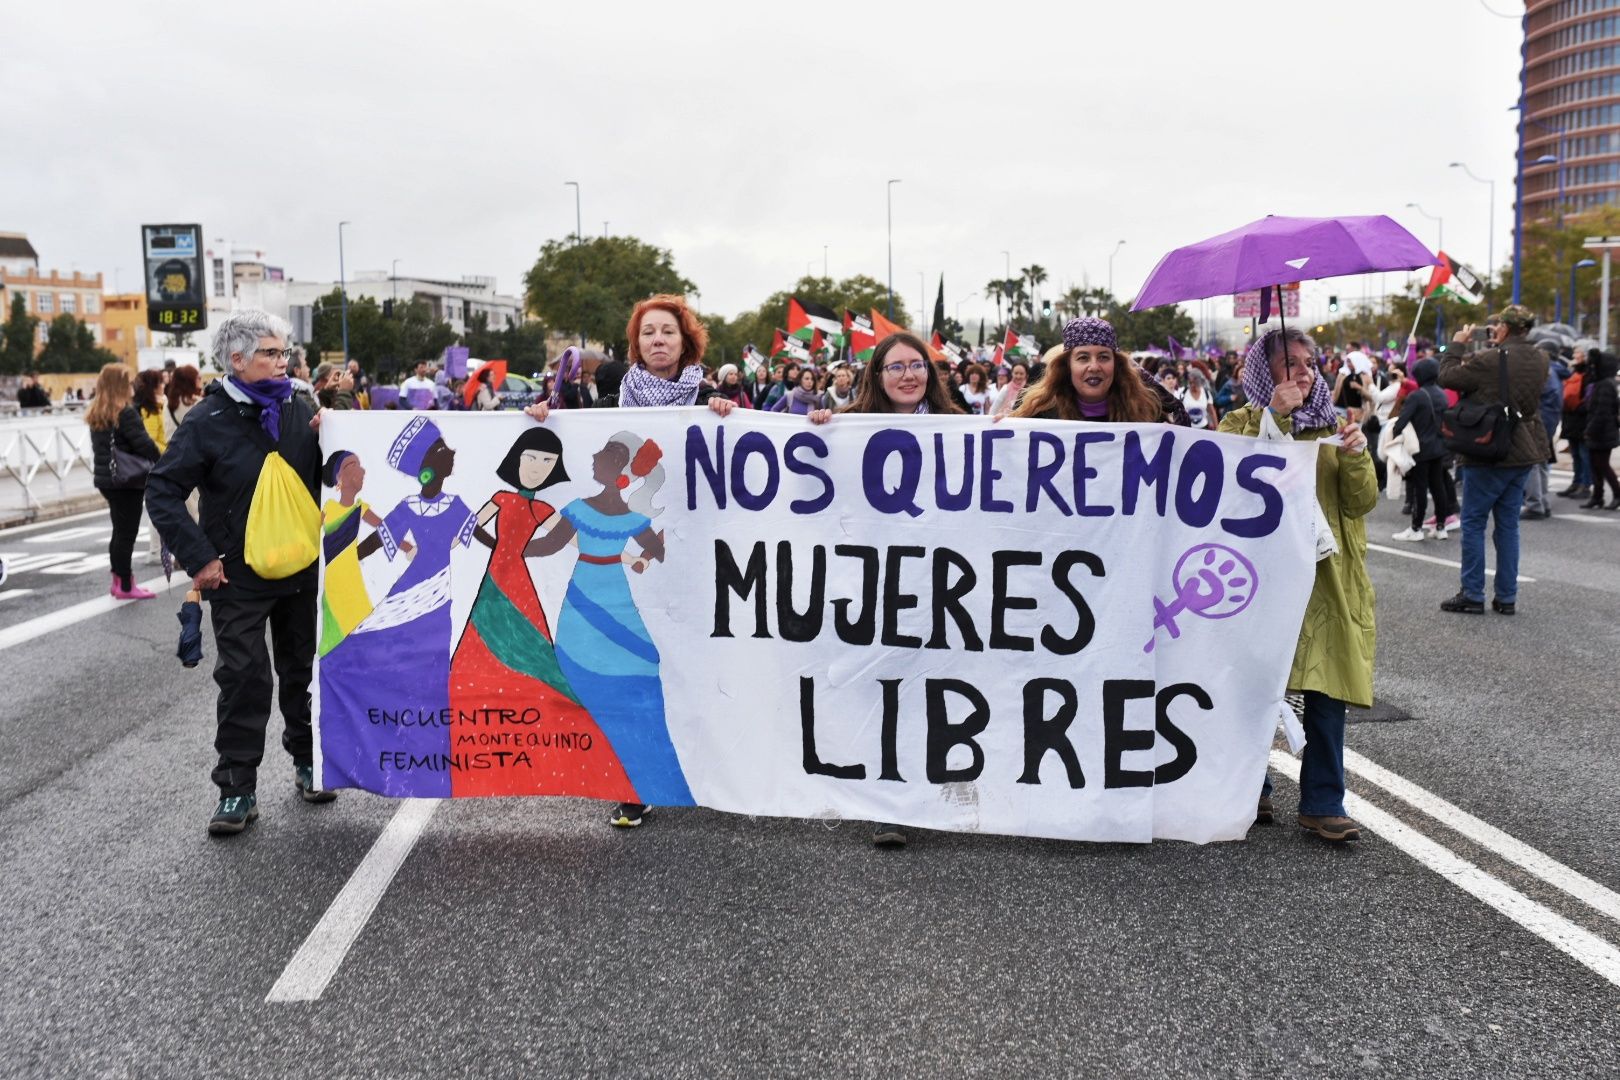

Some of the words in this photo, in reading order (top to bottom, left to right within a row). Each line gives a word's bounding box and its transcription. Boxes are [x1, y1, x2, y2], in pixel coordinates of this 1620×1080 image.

[160, 310, 198, 324] 18:32
[685, 424, 834, 514] NOS
[862, 428, 1287, 538] QUEREMOS
[710, 539, 1106, 656] MUJERES
[367, 707, 541, 728] ENCUENTRO
[799, 676, 1214, 789] LIBRES
[379, 751, 533, 772] FEMINISTA
